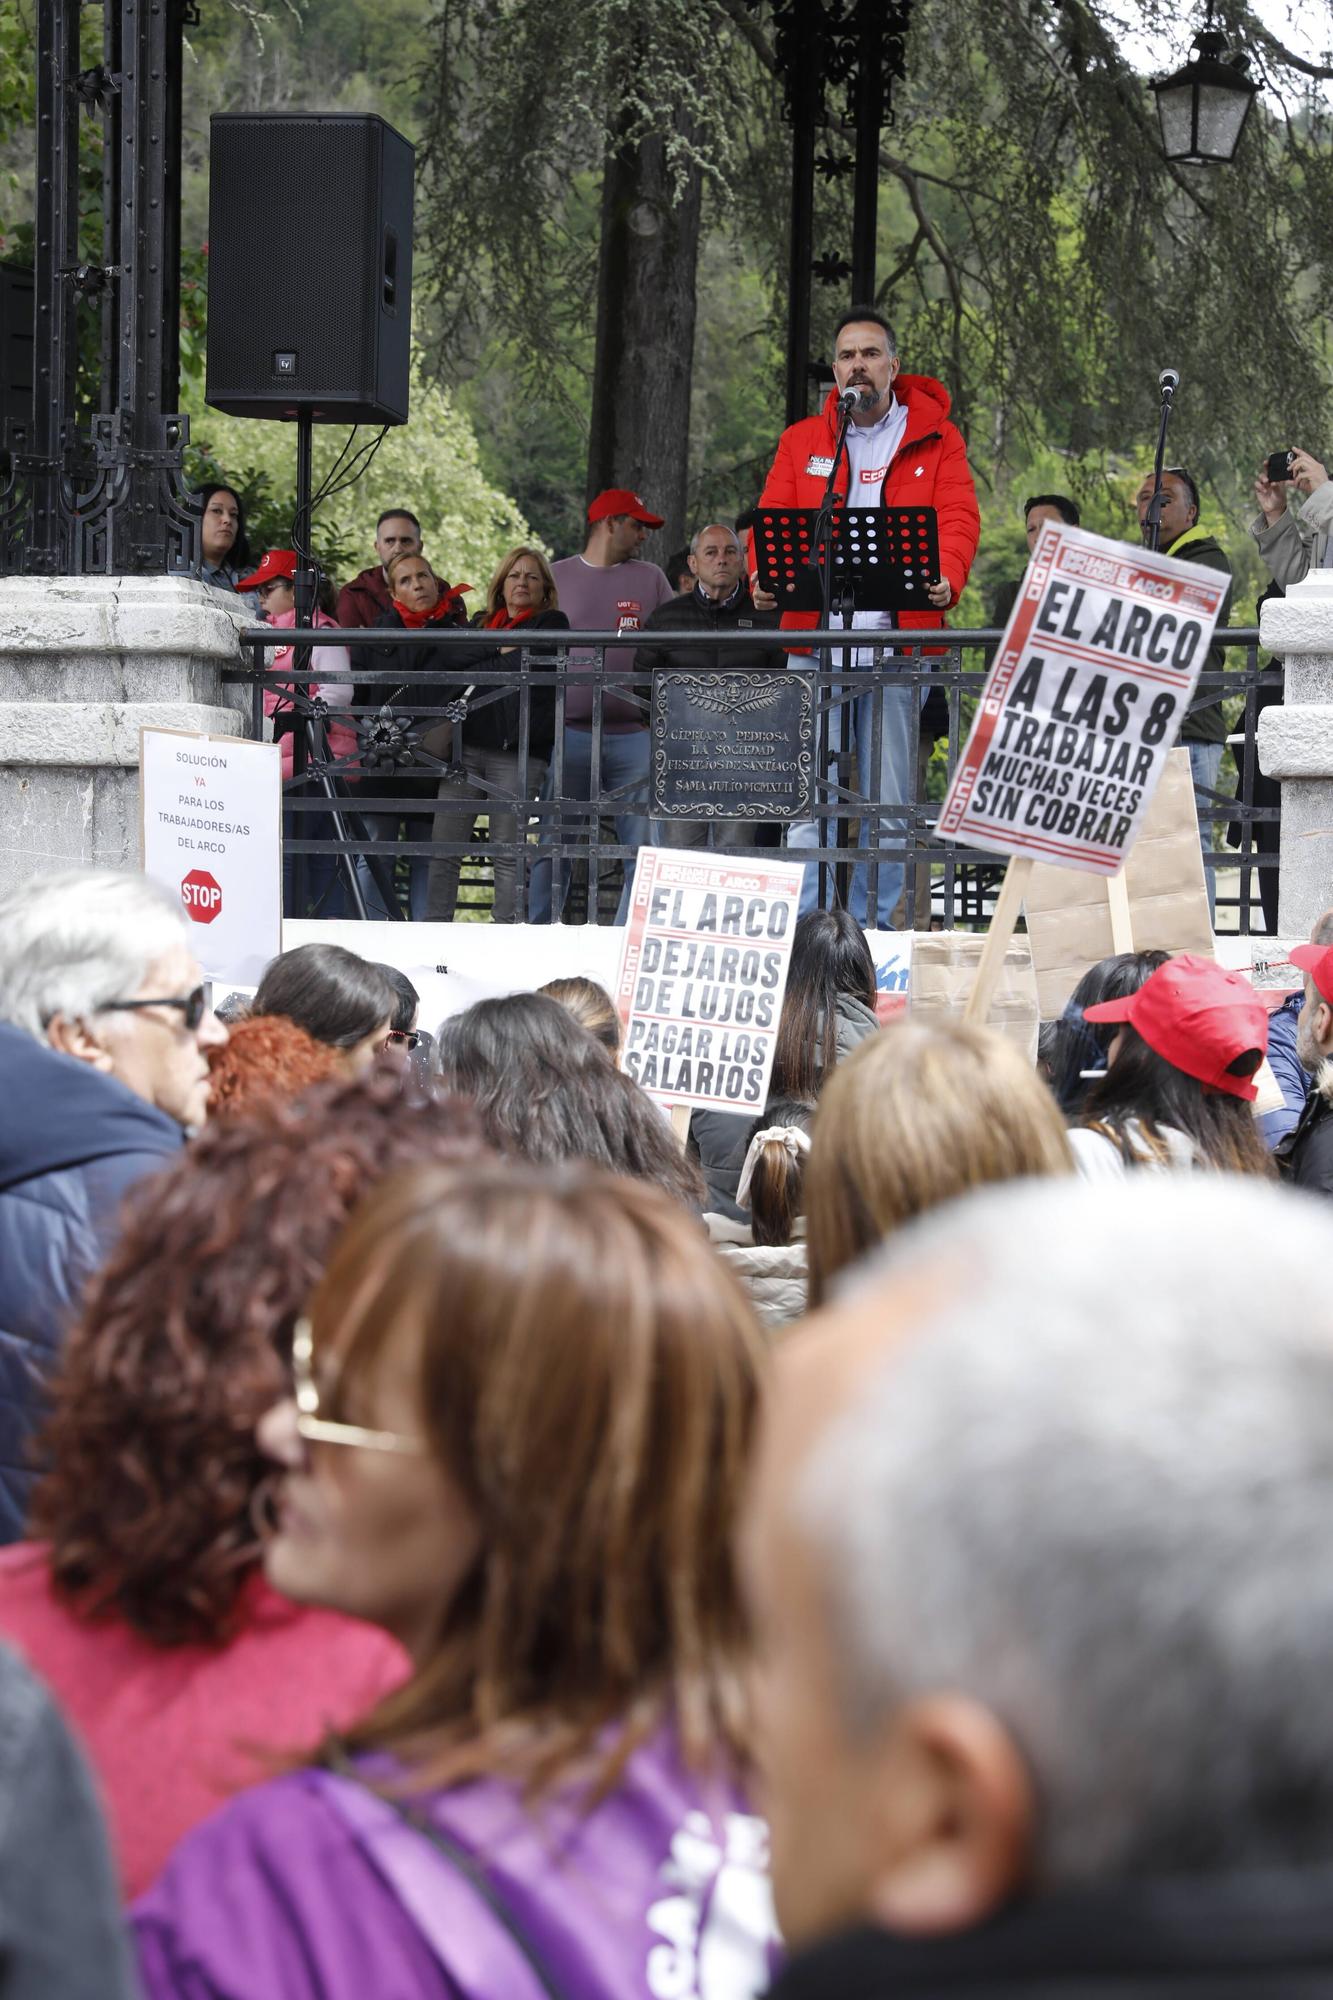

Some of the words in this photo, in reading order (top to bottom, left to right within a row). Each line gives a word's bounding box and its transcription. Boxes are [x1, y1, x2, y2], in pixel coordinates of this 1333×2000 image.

[620, 616, 639, 628] UGT
[1037, 580, 1085, 640] EL
[1091, 599, 1203, 671] ARCO
[1007, 656, 1045, 712] A
[1052, 666, 1140, 736] LAS
[1141, 692, 1177, 746] 8
[176, 751, 227, 769] SOLUCIÓN
[714, 743, 775, 756] SOCIEDAD
[998, 710, 1154, 787] TRABAJAR
[178, 795, 202, 808] PARA
[204, 799, 225, 811] LOS
[194, 776, 206, 787] YA
[982, 752, 1073, 798] MUCHAS
[1079, 772, 1143, 815] VECES
[158, 812, 250, 836] TRABAJADORES/AS
[972, 779, 1023, 822] SIN
[1024, 794, 1132, 848] COBRAR
[177, 837, 196, 849] DEL
[197, 841, 226, 854] ARCO
[182, 882, 221, 908] STOP
[651, 887, 687, 929] EL
[696, 893, 789, 940] ARCO
[640, 937, 782, 989] DEJAROS
[634, 977, 674, 1014] DE
[681, 983, 776, 1028] LUJOS
[628, 1020, 713, 1060] PAGAR
[719, 1031, 768, 1066] LOS
[624, 1051, 764, 1102] SALARIOS
